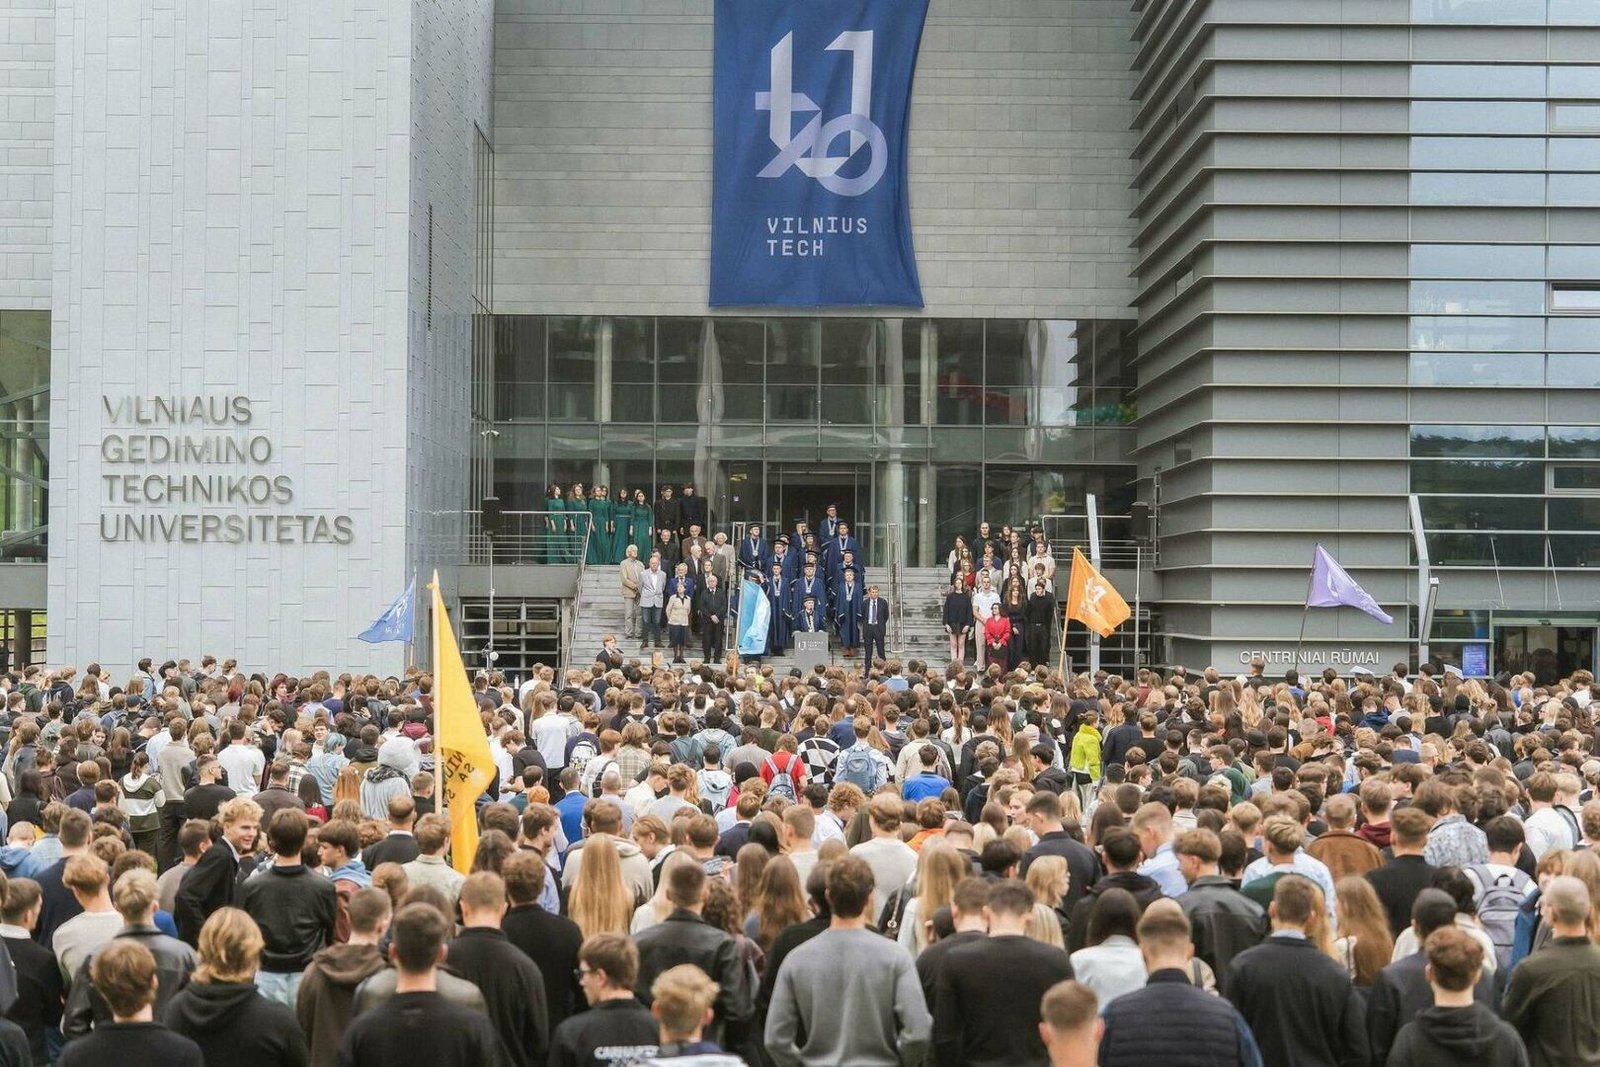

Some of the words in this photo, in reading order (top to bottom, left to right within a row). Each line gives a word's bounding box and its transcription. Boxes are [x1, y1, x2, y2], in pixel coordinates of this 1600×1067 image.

[767, 216, 868, 235] VILNIUS
[767, 239, 824, 257] TECH
[102, 395, 253, 426] VILNIAUS
[101, 434, 272, 465] GEDIMINO
[102, 474, 294, 505] TECHNIKOS
[100, 513, 355, 545] UNIVERSITETAS
[1330, 648, 1380, 664] RŪMAI
